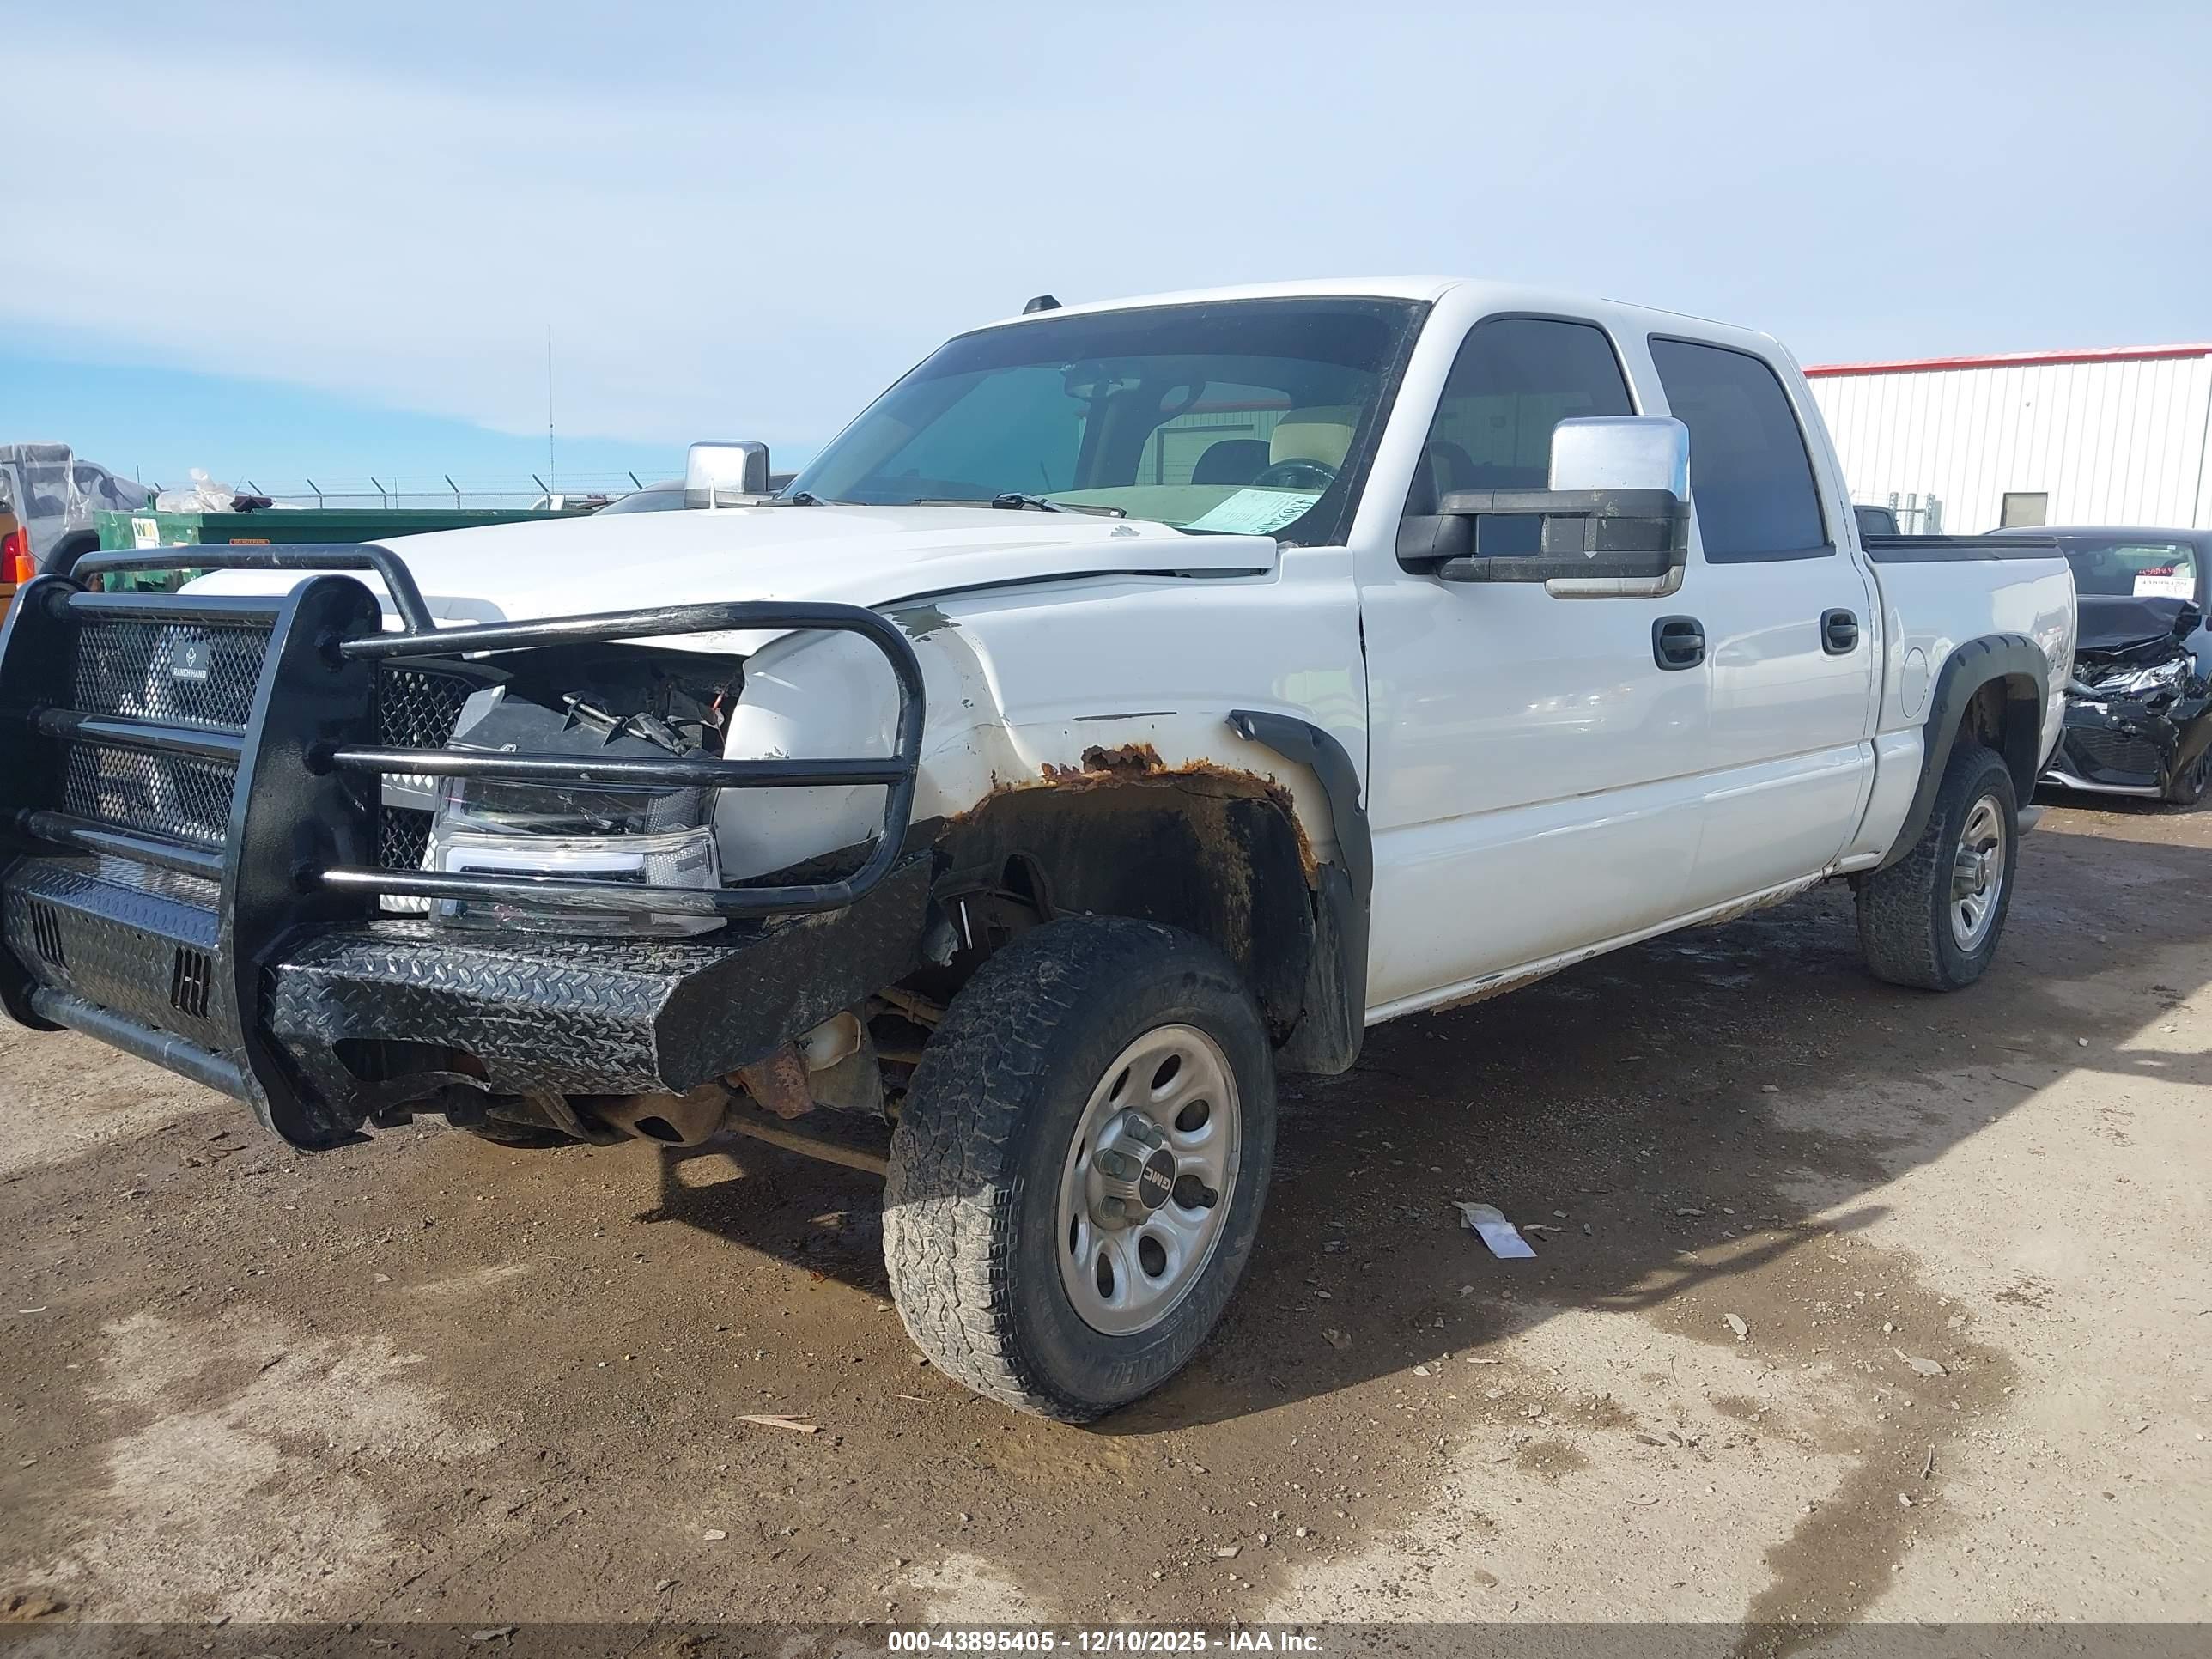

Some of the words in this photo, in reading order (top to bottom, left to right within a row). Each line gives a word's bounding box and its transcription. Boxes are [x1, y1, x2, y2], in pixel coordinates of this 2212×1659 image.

[1250, 500, 1314, 533] 43895405
[134, 522, 155, 537] WM
[173, 667, 191, 678] RANCH
[191, 669, 207, 679] HAND
[1143, 1166, 1171, 1191] GMC
